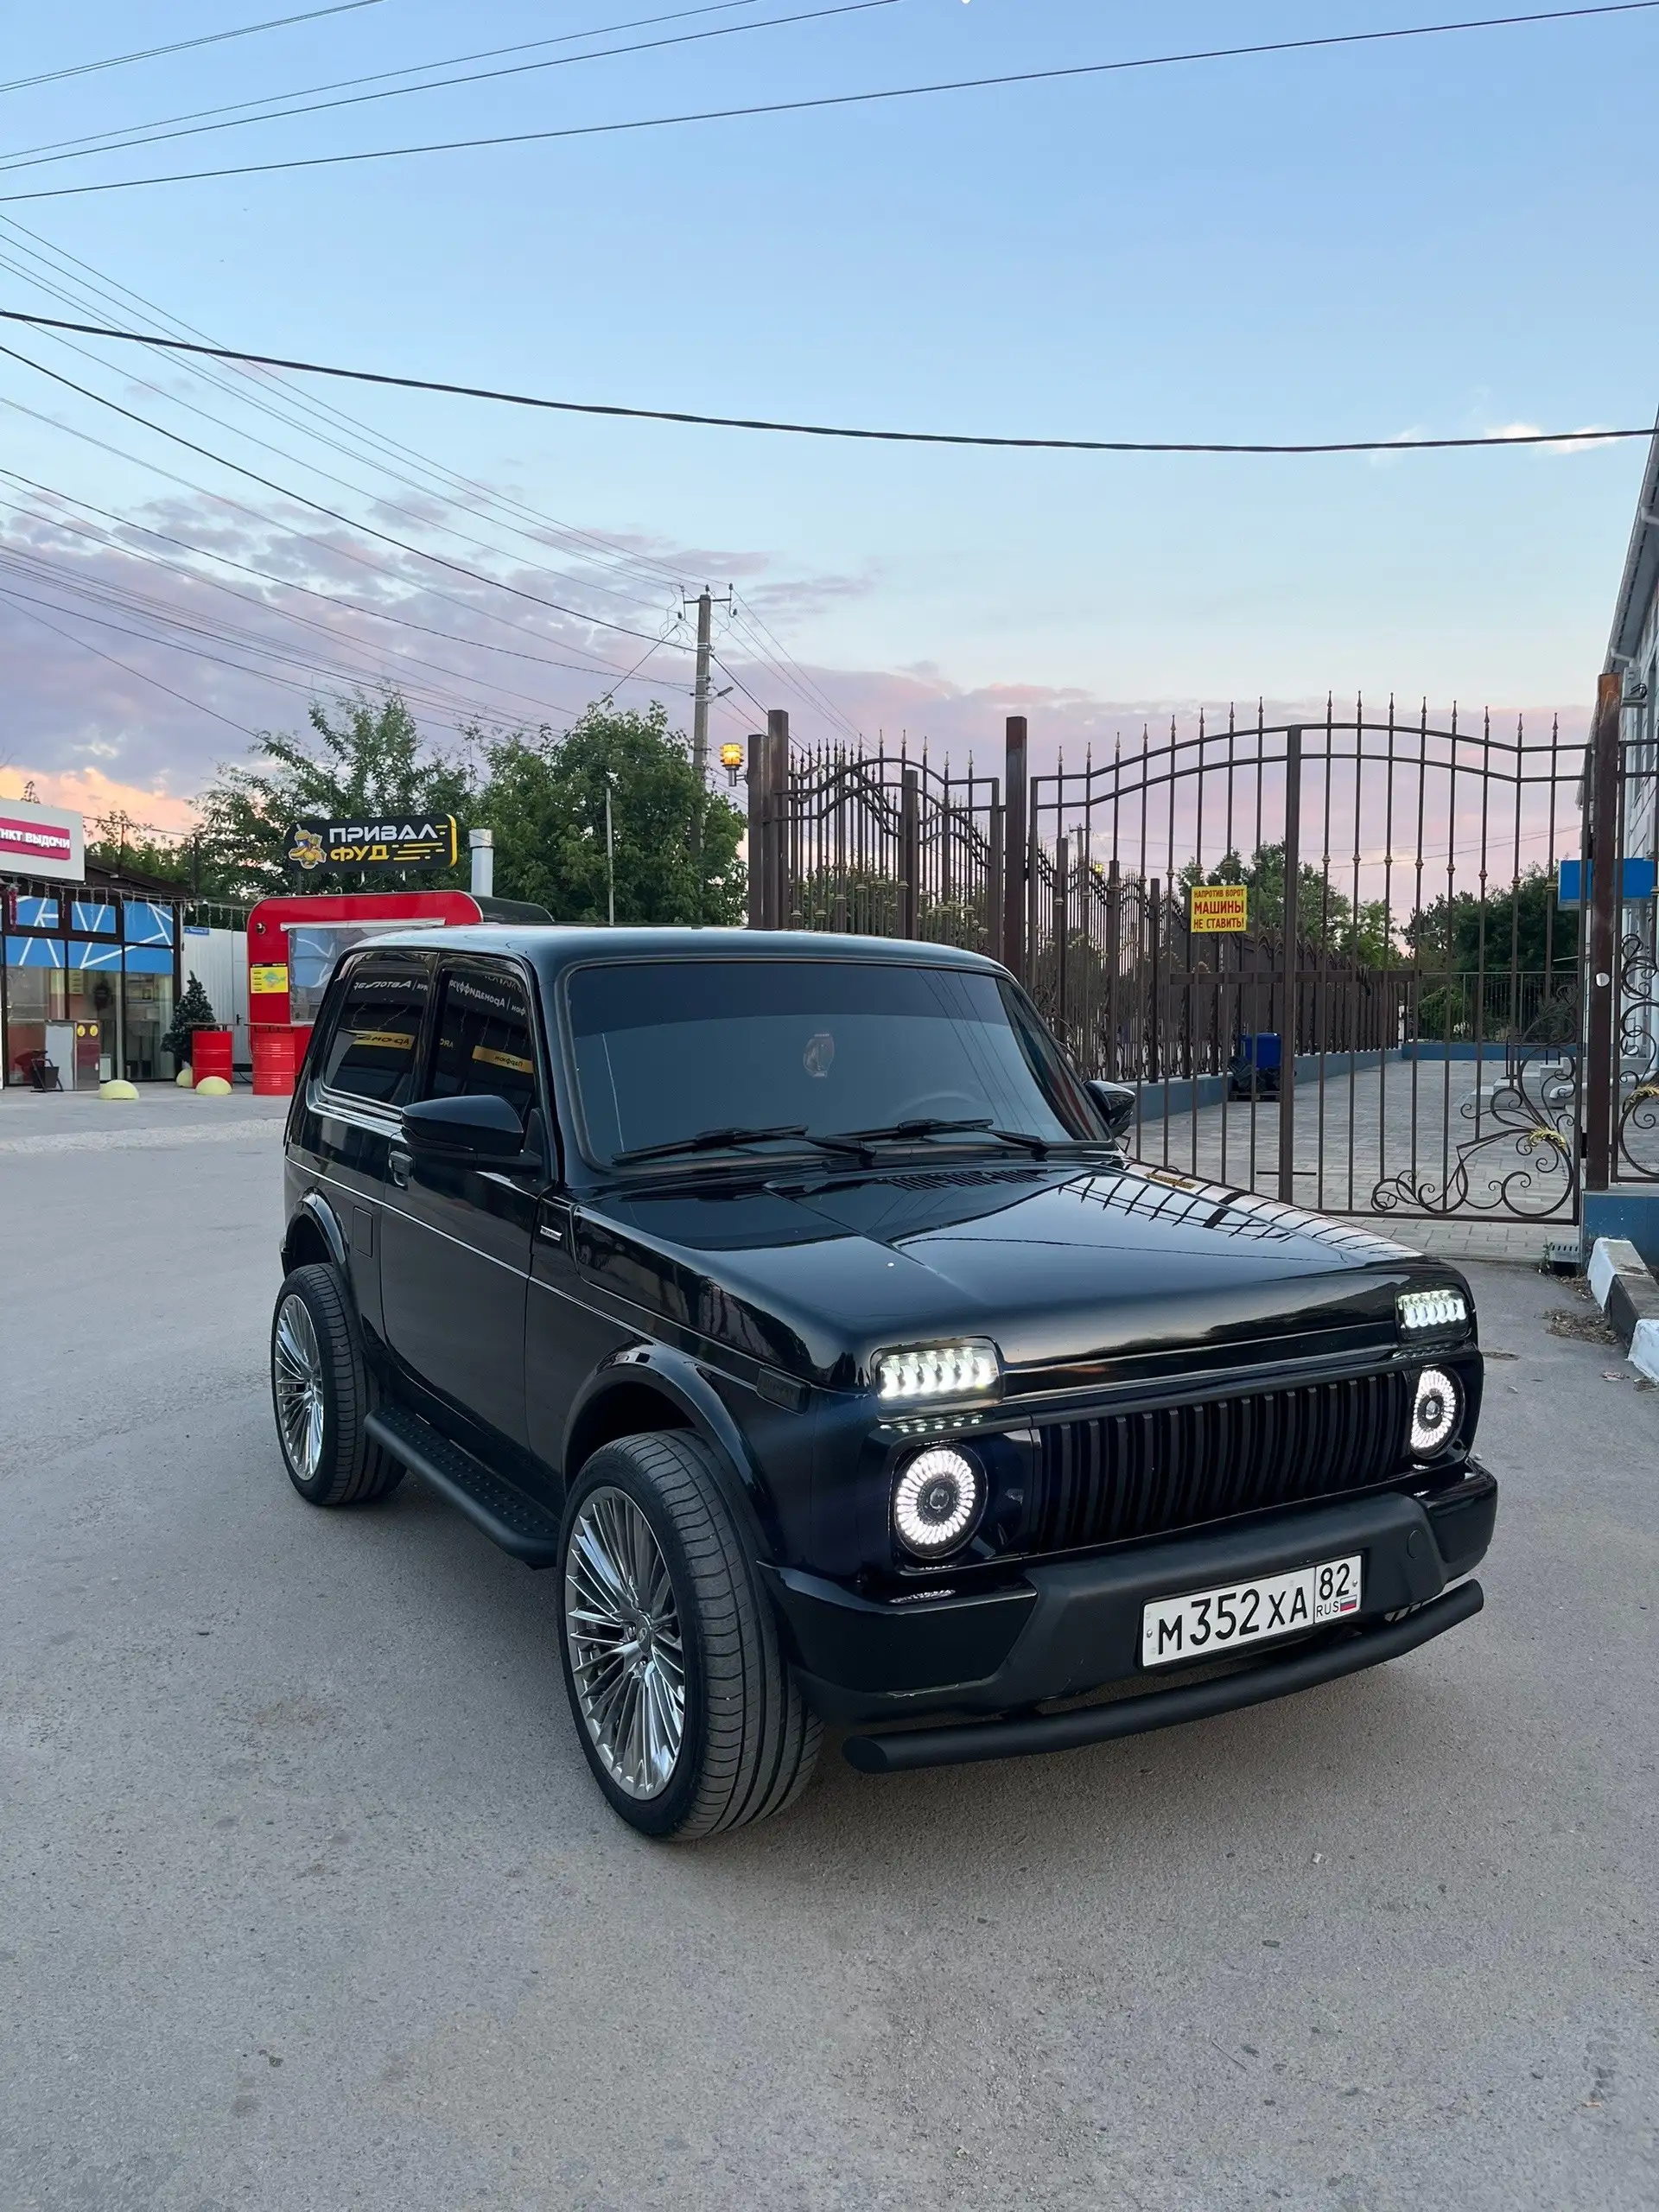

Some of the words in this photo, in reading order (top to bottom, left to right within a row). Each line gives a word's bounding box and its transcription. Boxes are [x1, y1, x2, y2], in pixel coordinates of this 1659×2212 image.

[329, 823, 438, 843] ПРИВАЛ
[330, 844, 390, 861] ФУД
[1225, 888, 1244, 897] ВОРОТ
[1194, 900, 1244, 914] МАШИНЫ
[1193, 918, 1204, 929] НЕ
[1206, 918, 1244, 928] СТАВИТЬ!
[1319, 1563, 1350, 1600] 82
[1316, 1600, 1339, 1618] RUS
